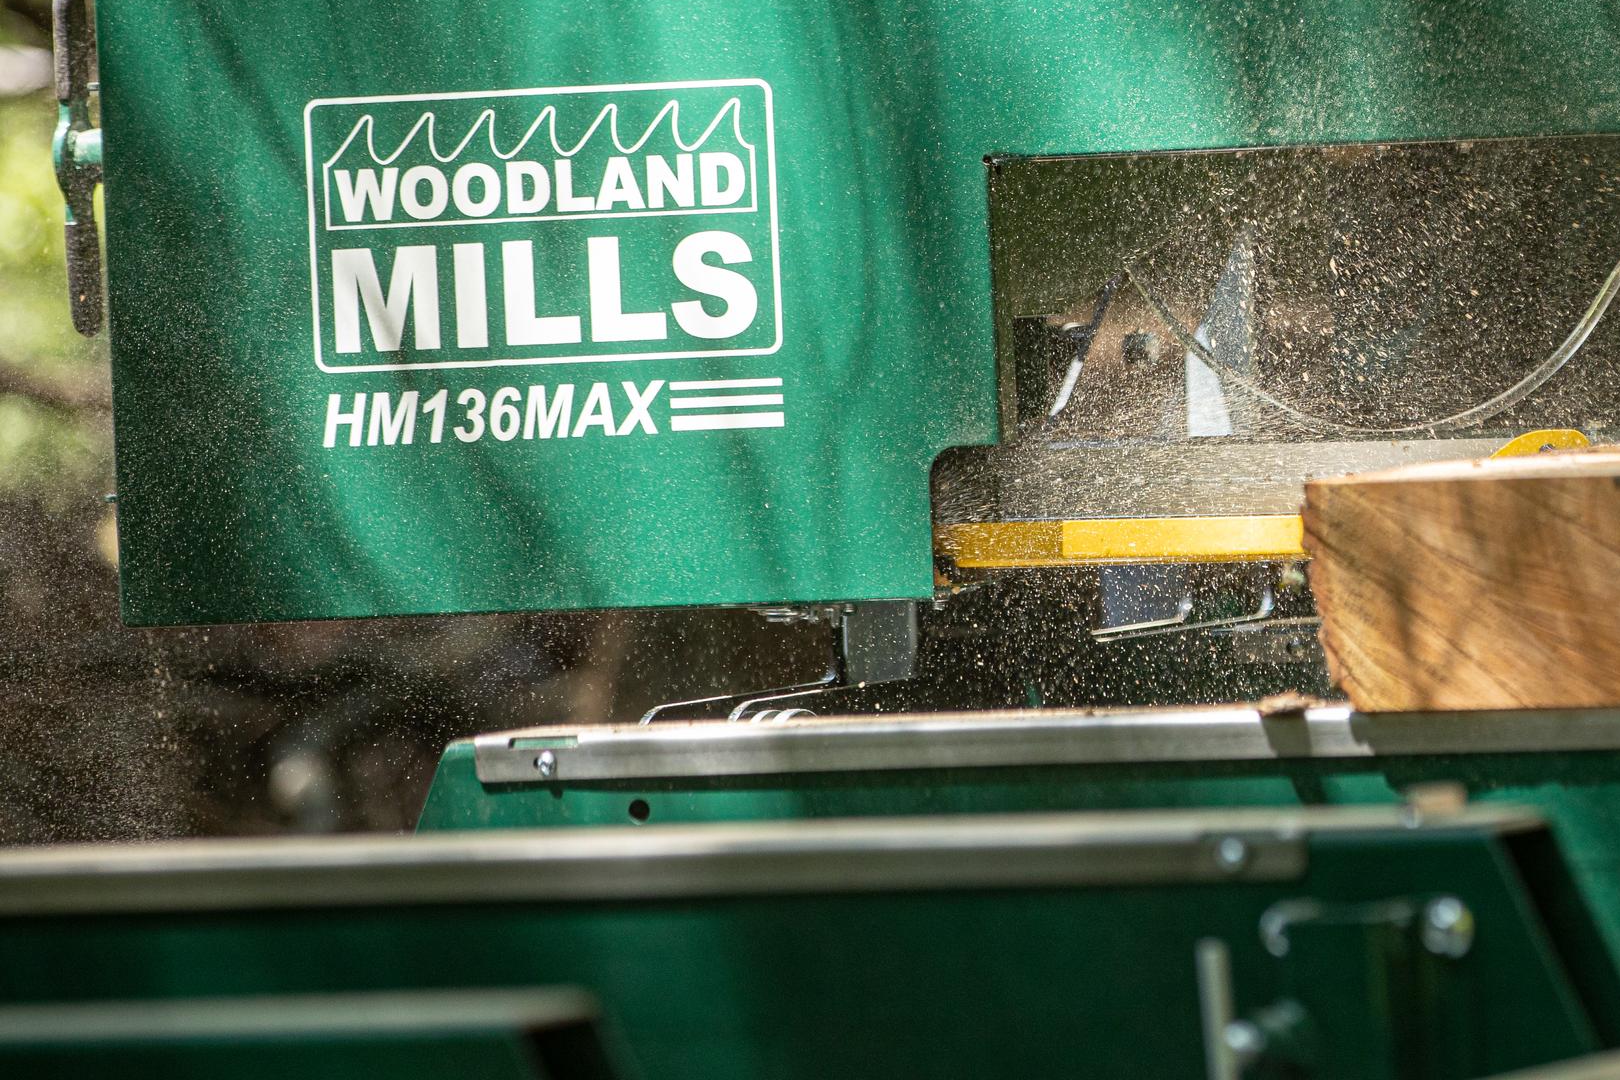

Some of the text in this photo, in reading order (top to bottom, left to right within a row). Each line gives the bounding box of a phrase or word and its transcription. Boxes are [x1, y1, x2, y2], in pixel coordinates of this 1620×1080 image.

[334, 152, 746, 222] WOODLAND
[331, 230, 759, 354] MILLS
[323, 378, 665, 448] HM136MAX
